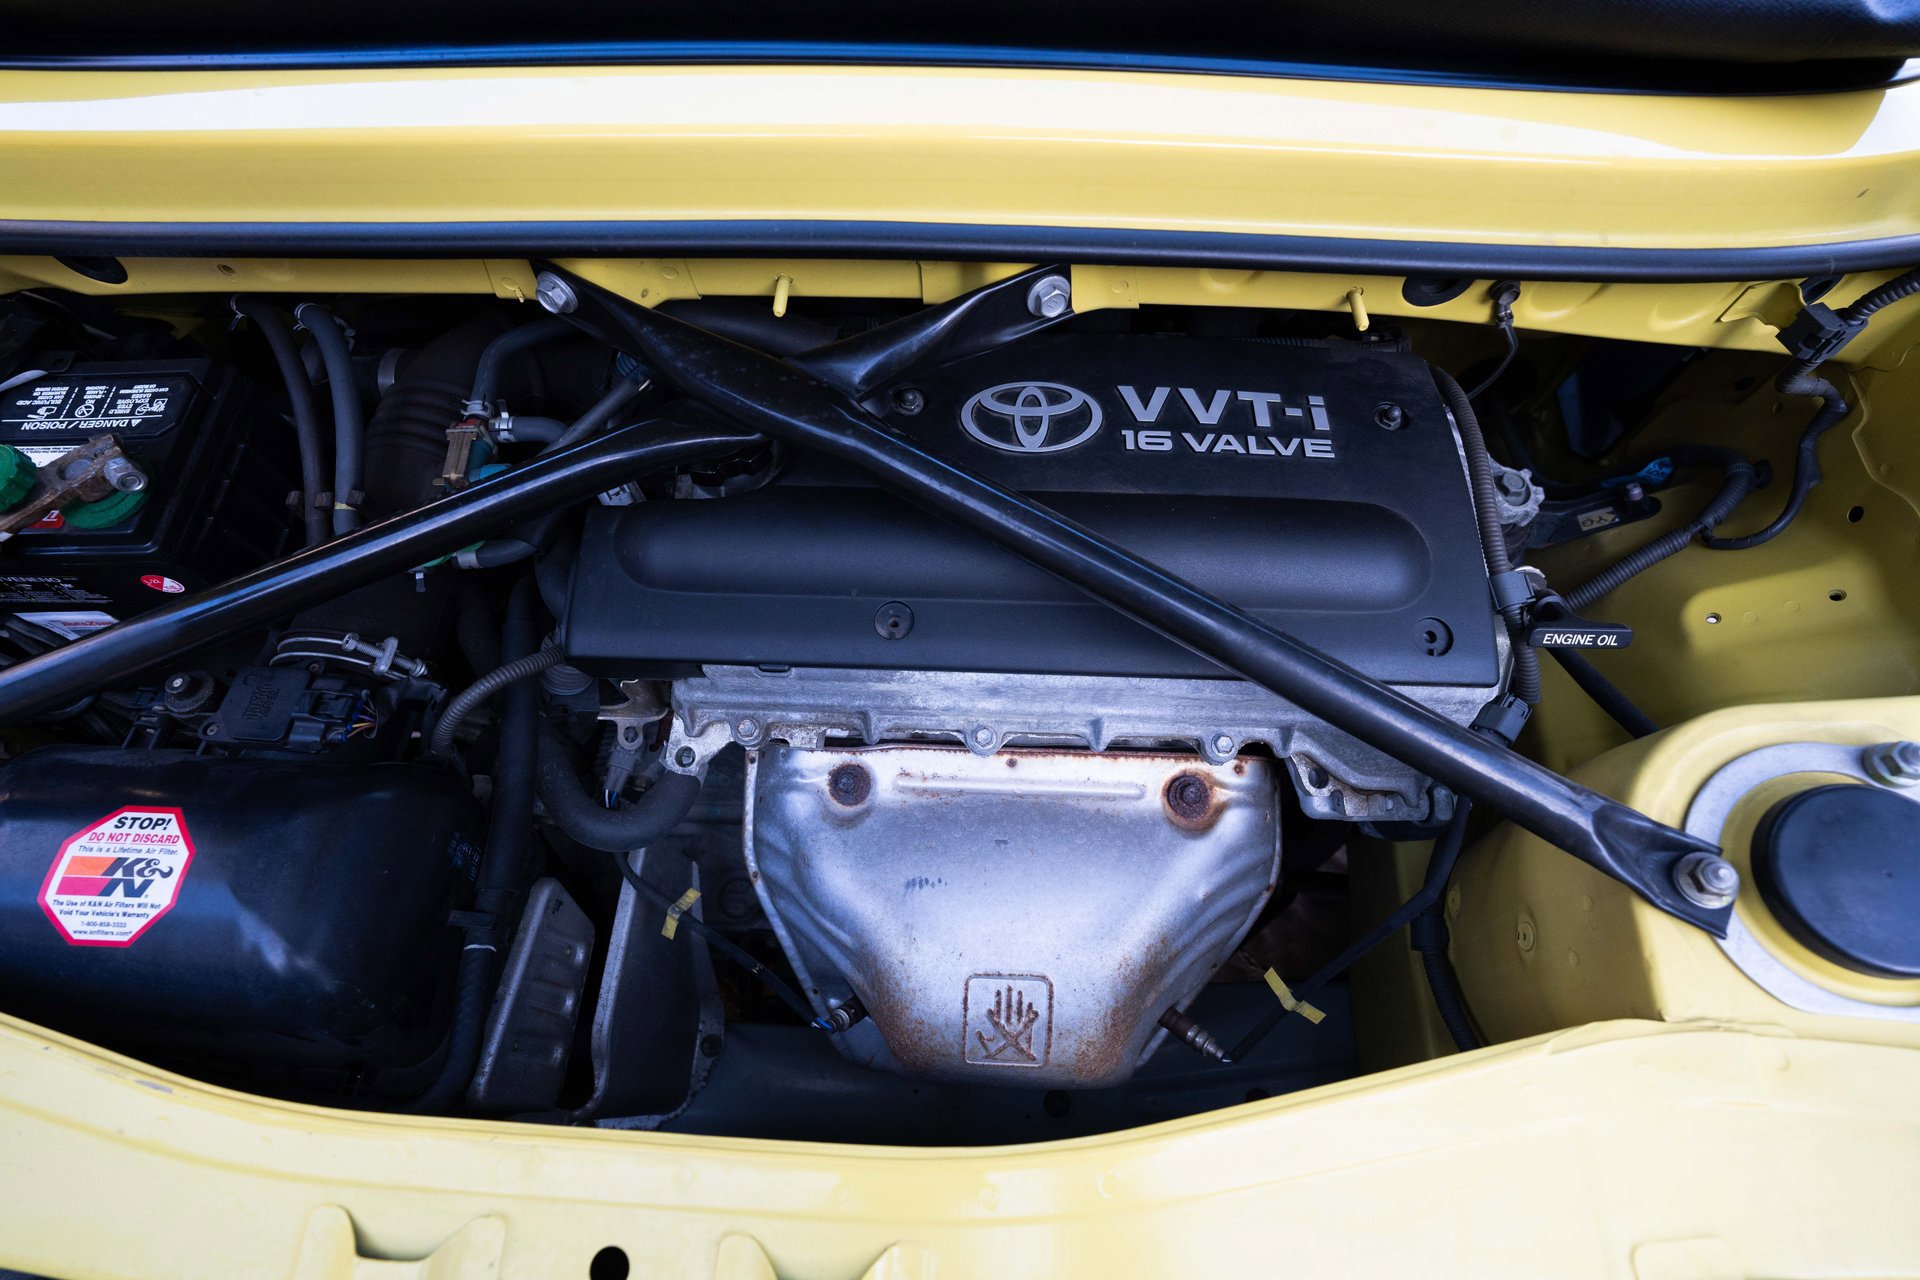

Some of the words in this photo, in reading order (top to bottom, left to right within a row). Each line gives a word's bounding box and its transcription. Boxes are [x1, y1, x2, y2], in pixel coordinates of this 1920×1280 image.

[1117, 385, 1330, 430] VVT-i
[21, 421, 68, 430] POISON
[79, 419, 129, 428] DANGER
[1121, 429, 1173, 451] 16
[1181, 432, 1335, 458] VALVE
[1542, 633, 1595, 645] ENGINE
[1597, 634, 1618, 646] OIL
[114, 816, 172, 830] STOP!
[88, 832, 105, 842] DO
[106, 833, 131, 843] NOT
[132, 834, 180, 844] DISCARD
[78, 845, 94, 853] This
[113, 846, 143, 855] Lifetime
